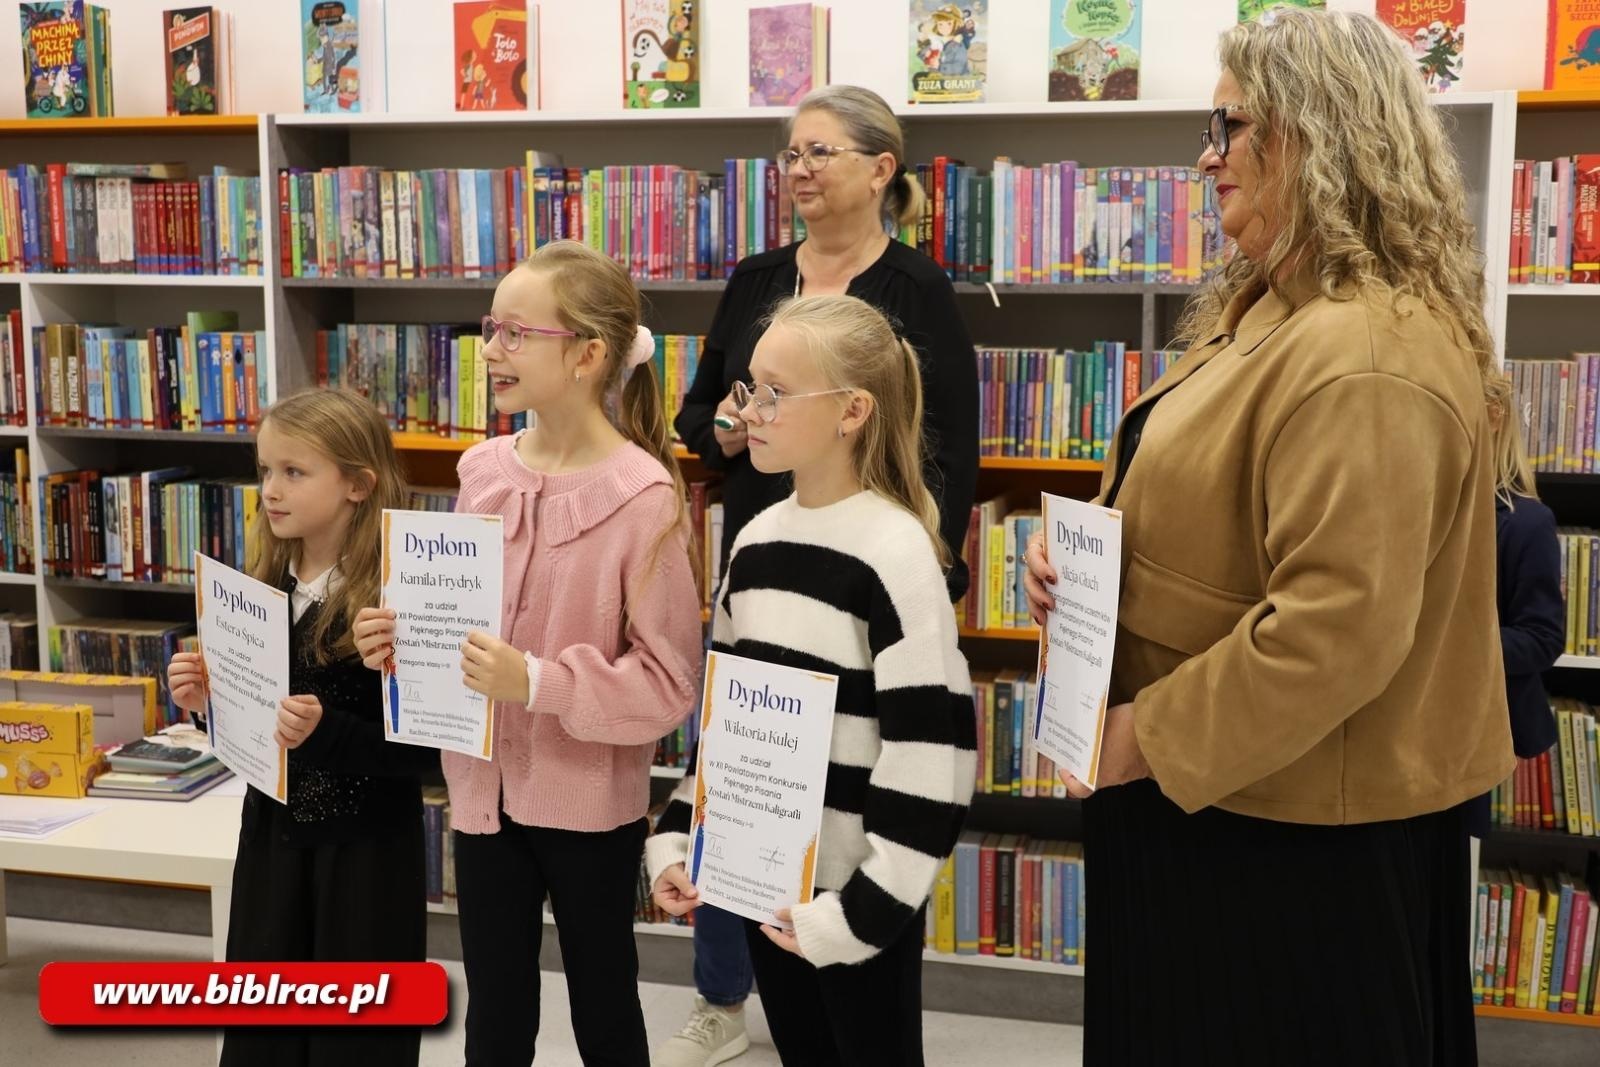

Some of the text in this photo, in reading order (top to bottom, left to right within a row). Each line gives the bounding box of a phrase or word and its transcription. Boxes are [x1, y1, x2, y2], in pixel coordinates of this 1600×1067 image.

[36, 37, 74, 56] PRZEZ
[38, 50, 72, 68] CHINY
[918, 80, 976, 90] ZUZA GRANT
[404, 532, 478, 562] Dyplom
[1057, 520, 1102, 556] Dyplom
[400, 571, 482, 592] Kamila Frydryk
[212, 580, 267, 622] Dyplom
[435, 602, 458, 612] udział
[408, 613, 456, 626] Powiatowym
[457, 616, 490, 628] Konkursie
[216, 615, 265, 649] Estera Śpica
[410, 626, 470, 638] Pięknego Pisani
[394, 638, 420, 649] Zostań
[421, 639, 456, 650] Mistrzem
[228, 647, 252, 664] za udział
[250, 664, 278, 688] Konkursie
[728, 678, 802, 715] Dyplom
[724, 719, 799, 754] Wiktoria Kulej
[740, 754, 771, 769] za udział
[716, 761, 724, 772] XII
[724, 763, 767, 784] Powiatowym
[768, 774, 808, 792] Konkursie
[724, 777, 782, 800] Pięknego Pisania
[708, 785, 801, 820] Zostań Mistrzem Kaligrafii
